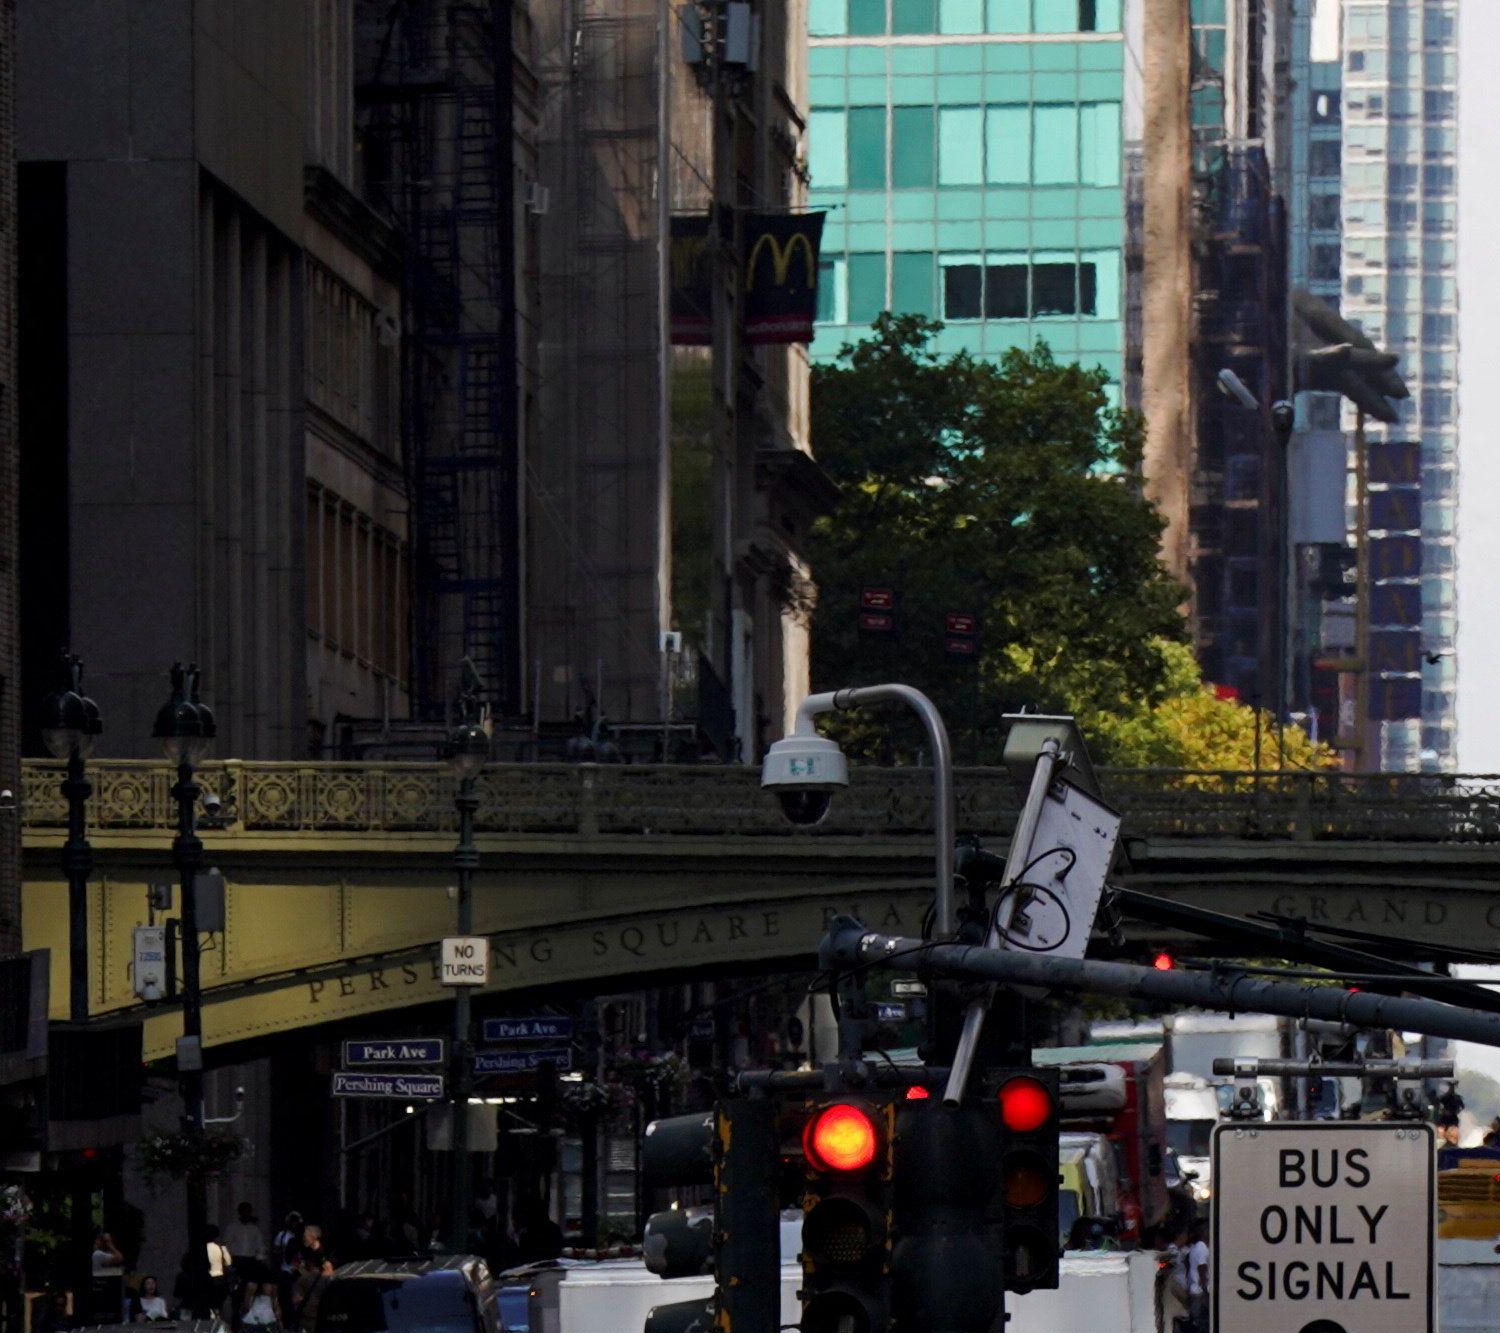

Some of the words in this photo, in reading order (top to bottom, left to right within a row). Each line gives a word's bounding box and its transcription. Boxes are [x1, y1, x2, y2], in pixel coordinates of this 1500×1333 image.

[1271, 893, 1451, 927] GRAND
[592, 910, 782, 957] SQUARE
[454, 945, 474, 958] NO
[444, 964, 485, 977] TURNS
[499, 1023, 527, 1037] Park
[530, 1022, 558, 1035] Ave
[363, 1046, 396, 1060] Park
[399, 1046, 427, 1059] Ave
[336, 1077, 393, 1095] Pershing
[395, 1078, 441, 1095] Square
[1279, 1148, 1371, 1188] BUS
[1260, 1204, 1389, 1245] ONLY
[1236, 1261, 1410, 1301] SIGNAL
